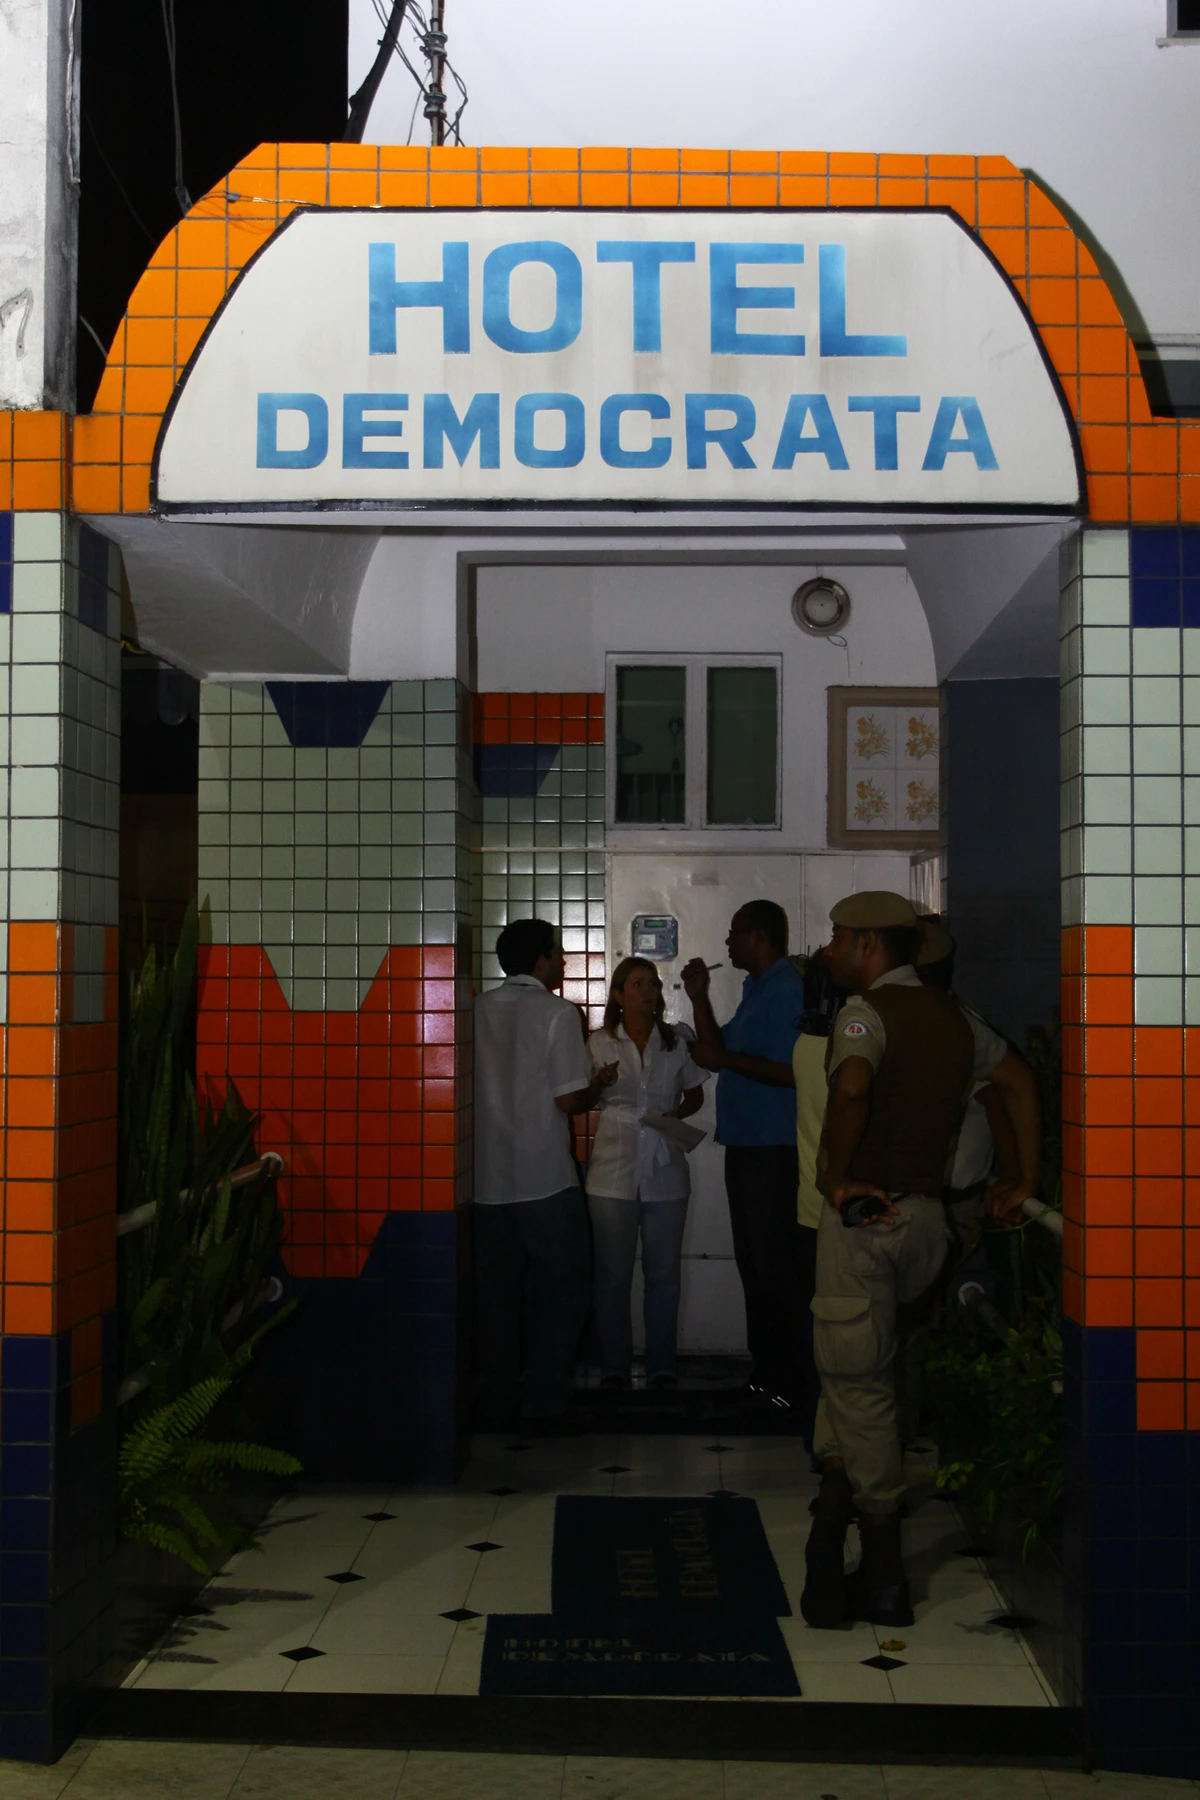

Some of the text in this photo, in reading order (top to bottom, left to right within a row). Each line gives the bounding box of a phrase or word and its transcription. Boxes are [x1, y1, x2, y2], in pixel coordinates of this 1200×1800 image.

[368, 240, 907, 358] HOTEL
[256, 392, 1000, 472] DEMOCRATA
[503, 1637, 638, 1649] HOTEL
